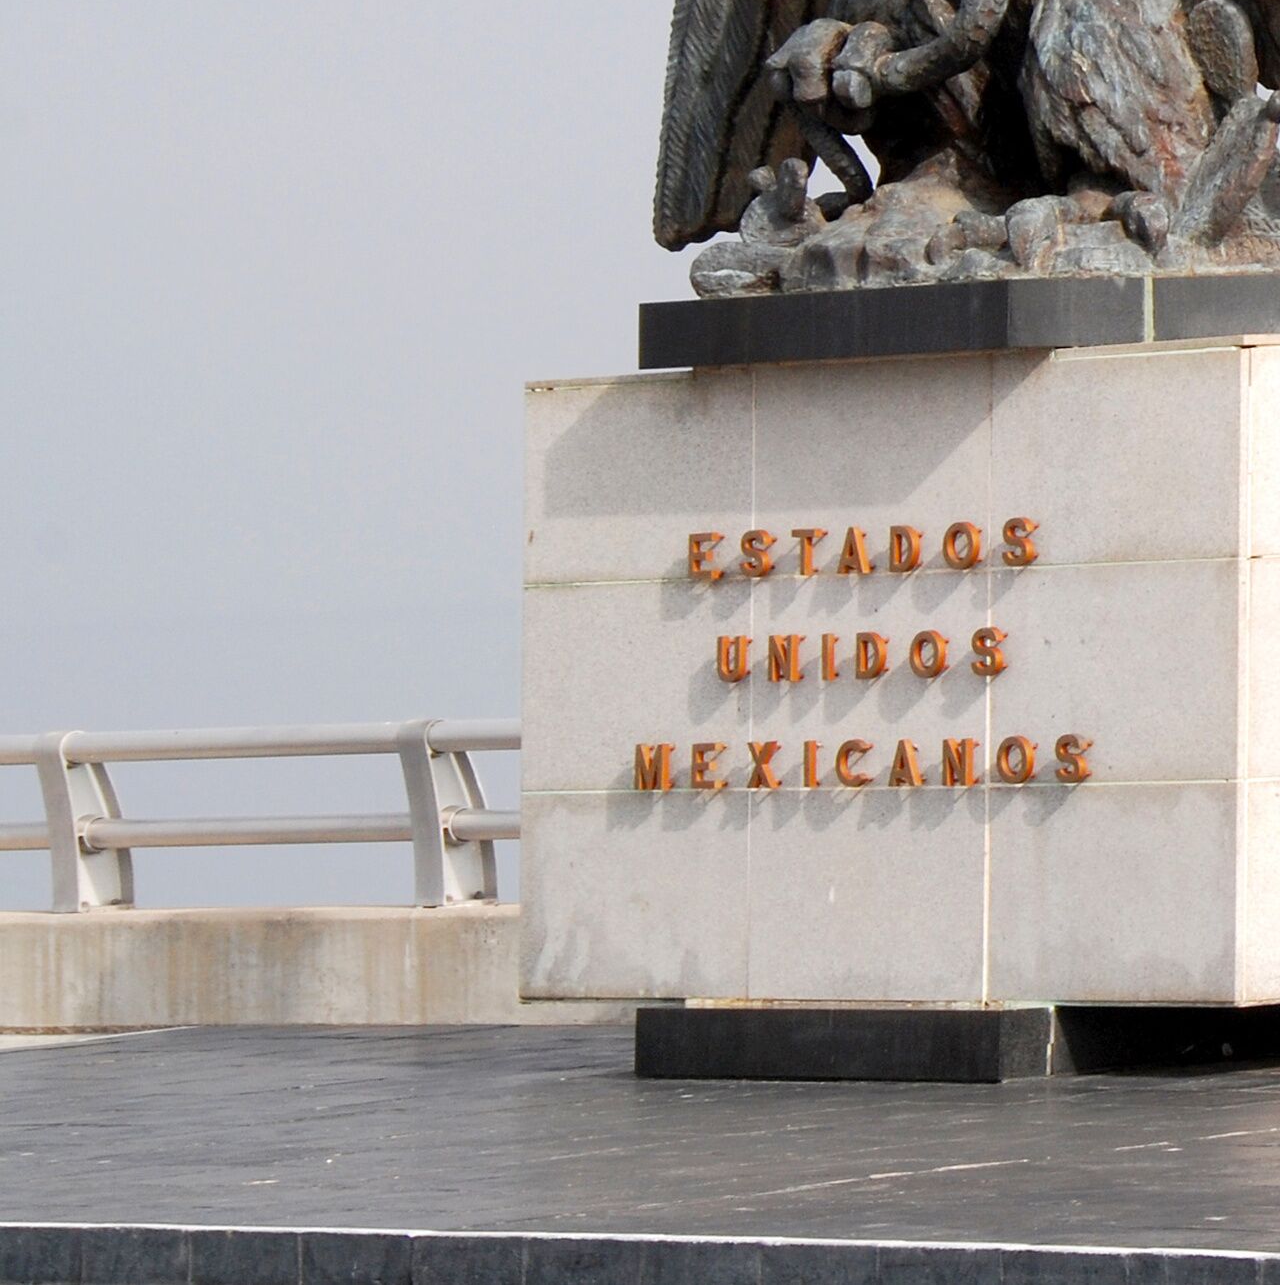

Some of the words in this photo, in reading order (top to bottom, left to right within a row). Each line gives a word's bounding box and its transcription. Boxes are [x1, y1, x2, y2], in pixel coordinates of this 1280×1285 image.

[688, 517, 1039, 580] ESTADOS
[716, 626, 1008, 682] UNIDOS
[634, 733, 1093, 792] MEXICANOS
